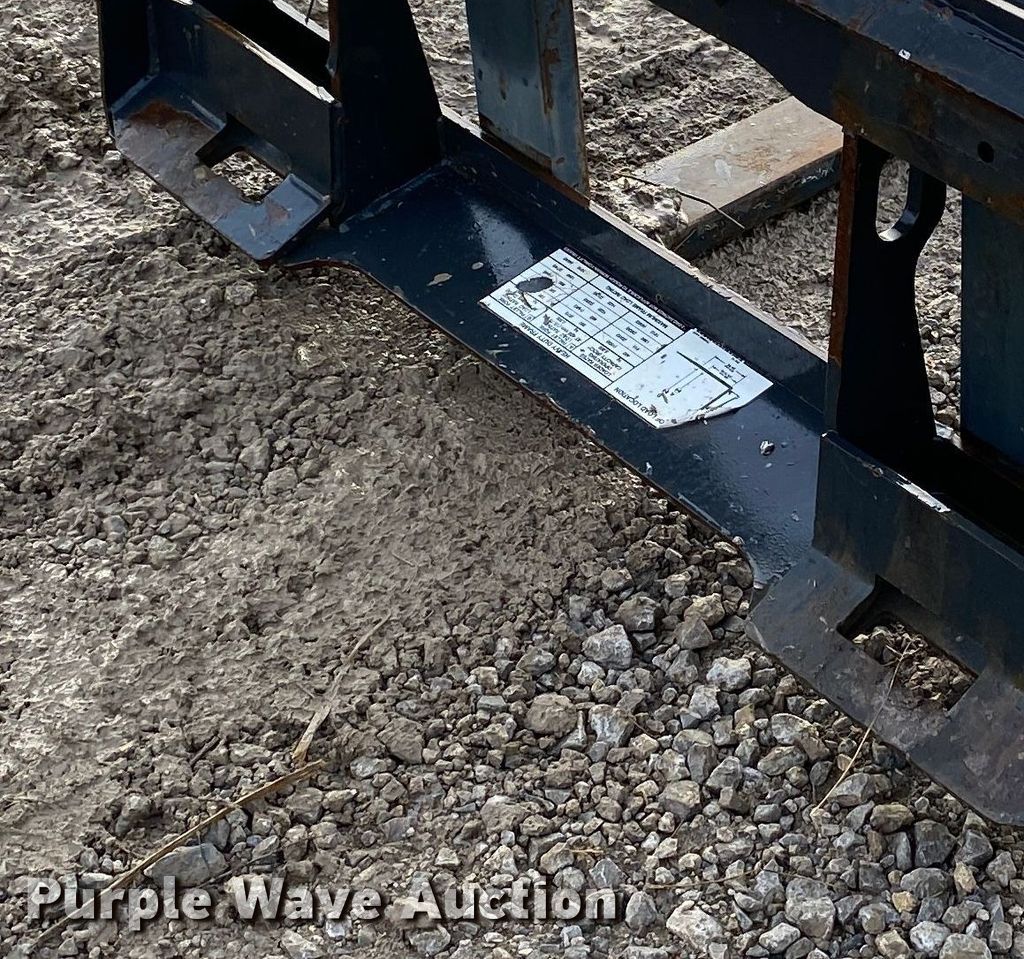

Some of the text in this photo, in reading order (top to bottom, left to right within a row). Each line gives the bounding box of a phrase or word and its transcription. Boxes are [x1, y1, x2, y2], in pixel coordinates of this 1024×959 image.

[535, 334, 553, 346] DUTY
[550, 345, 571, 358] HEAVY
[611, 387, 643, 407] LOCATION
